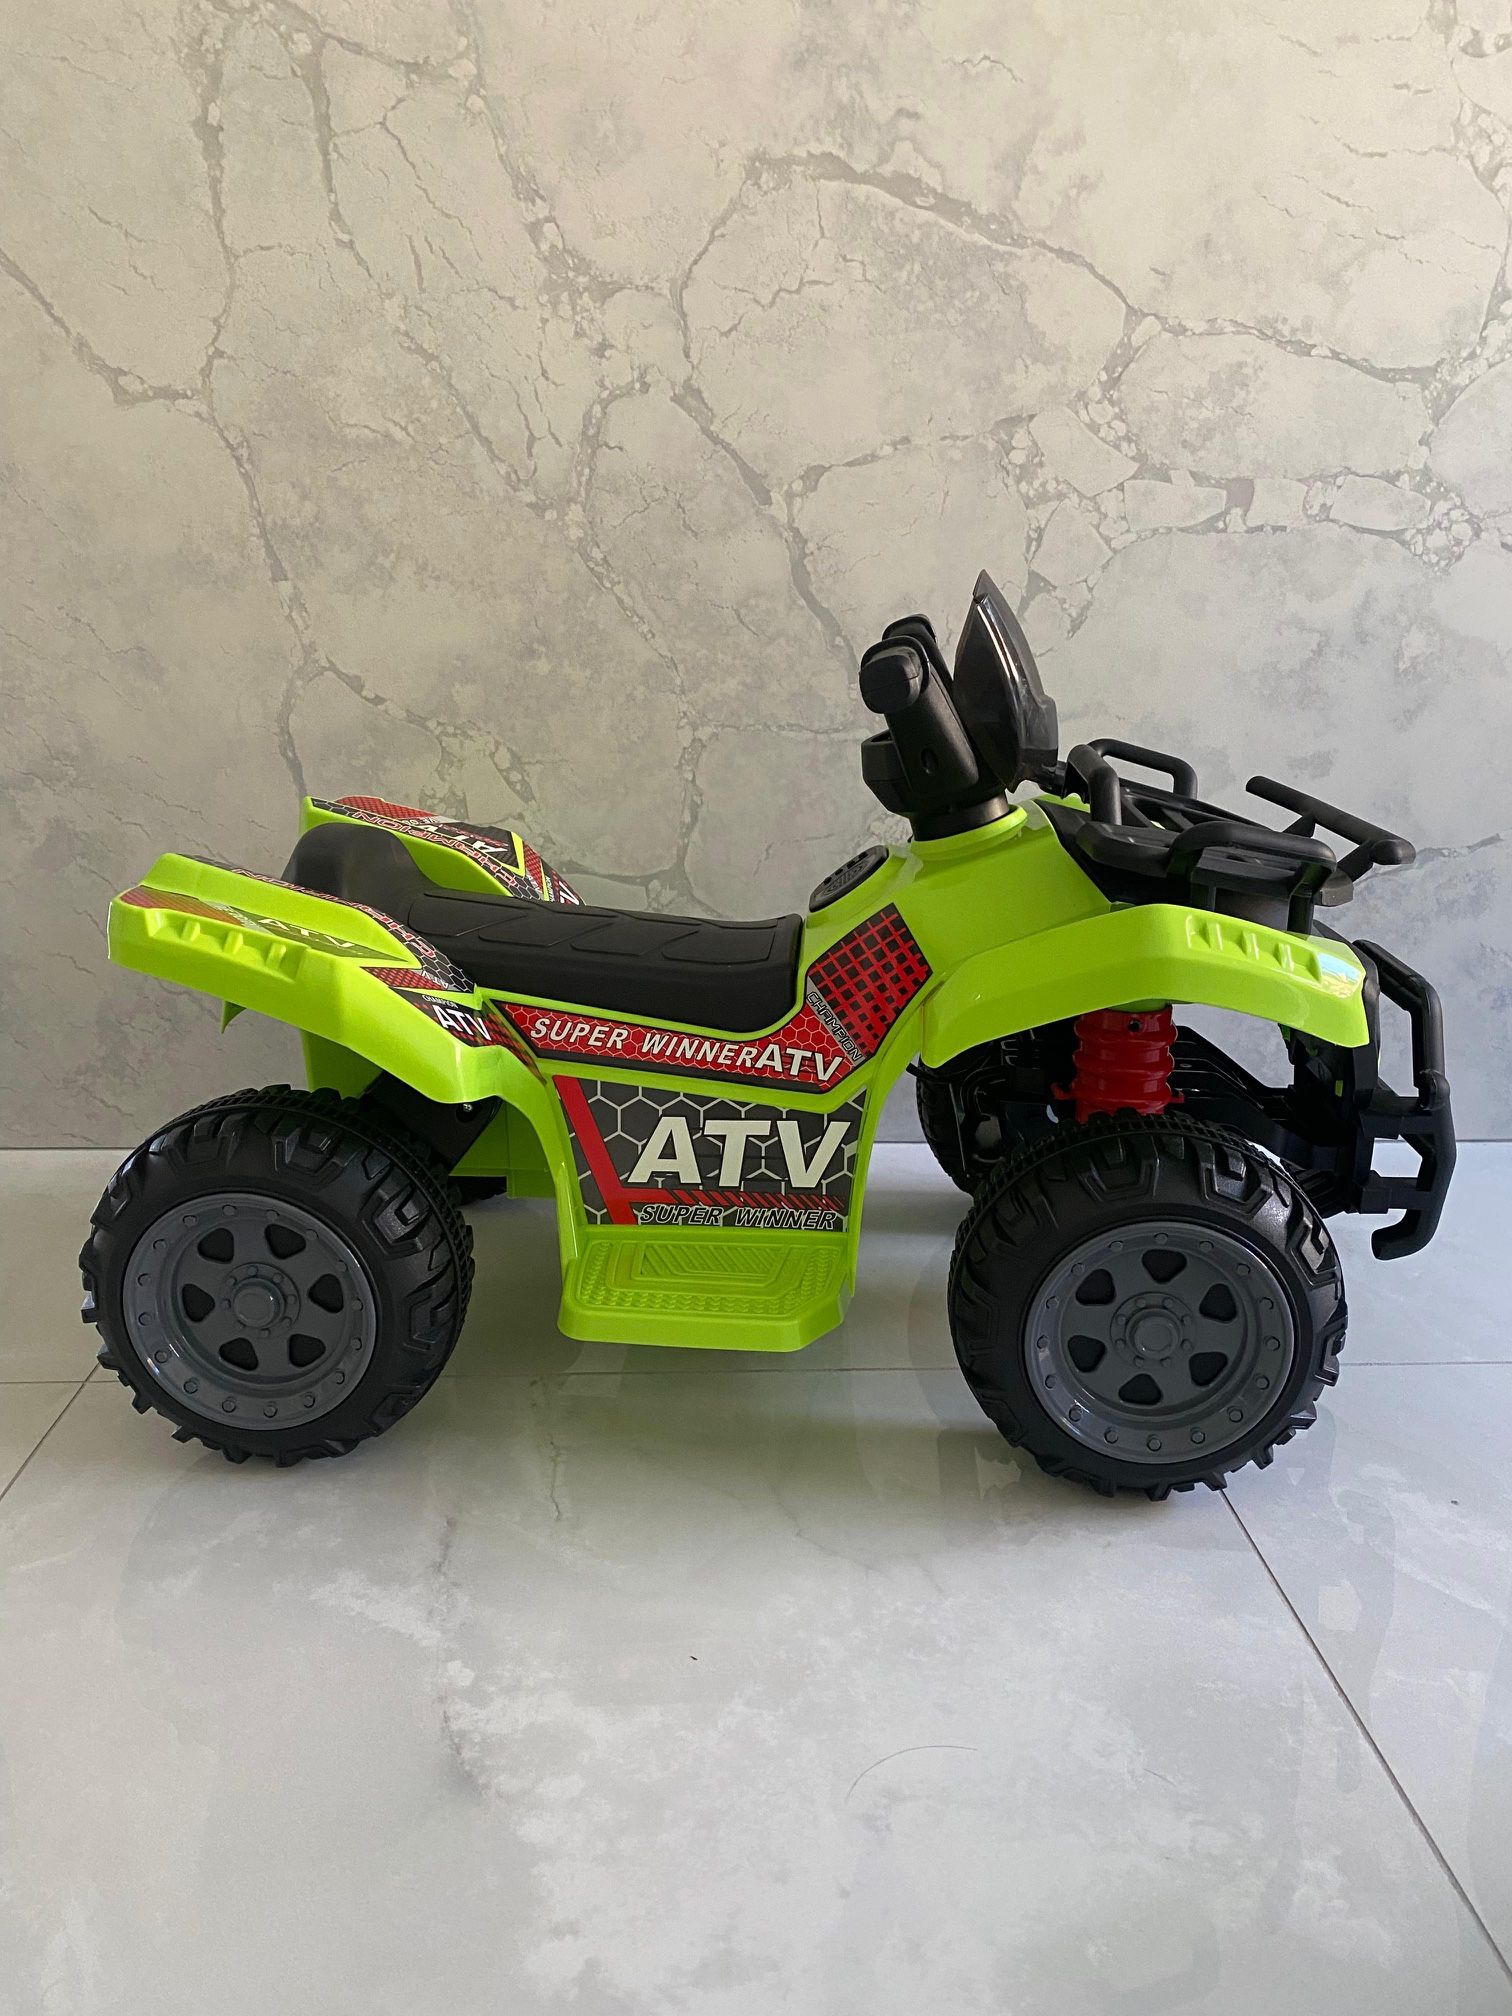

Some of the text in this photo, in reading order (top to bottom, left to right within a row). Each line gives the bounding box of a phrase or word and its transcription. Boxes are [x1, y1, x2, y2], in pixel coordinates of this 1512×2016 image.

[432, 1005, 492, 1041] ATV
[530, 1017, 629, 1050] SUPER
[806, 991, 863, 1063] CHAMPION
[627, 1116, 851, 1188] ATV
[639, 1204, 838, 1230] SUPER WINNER
